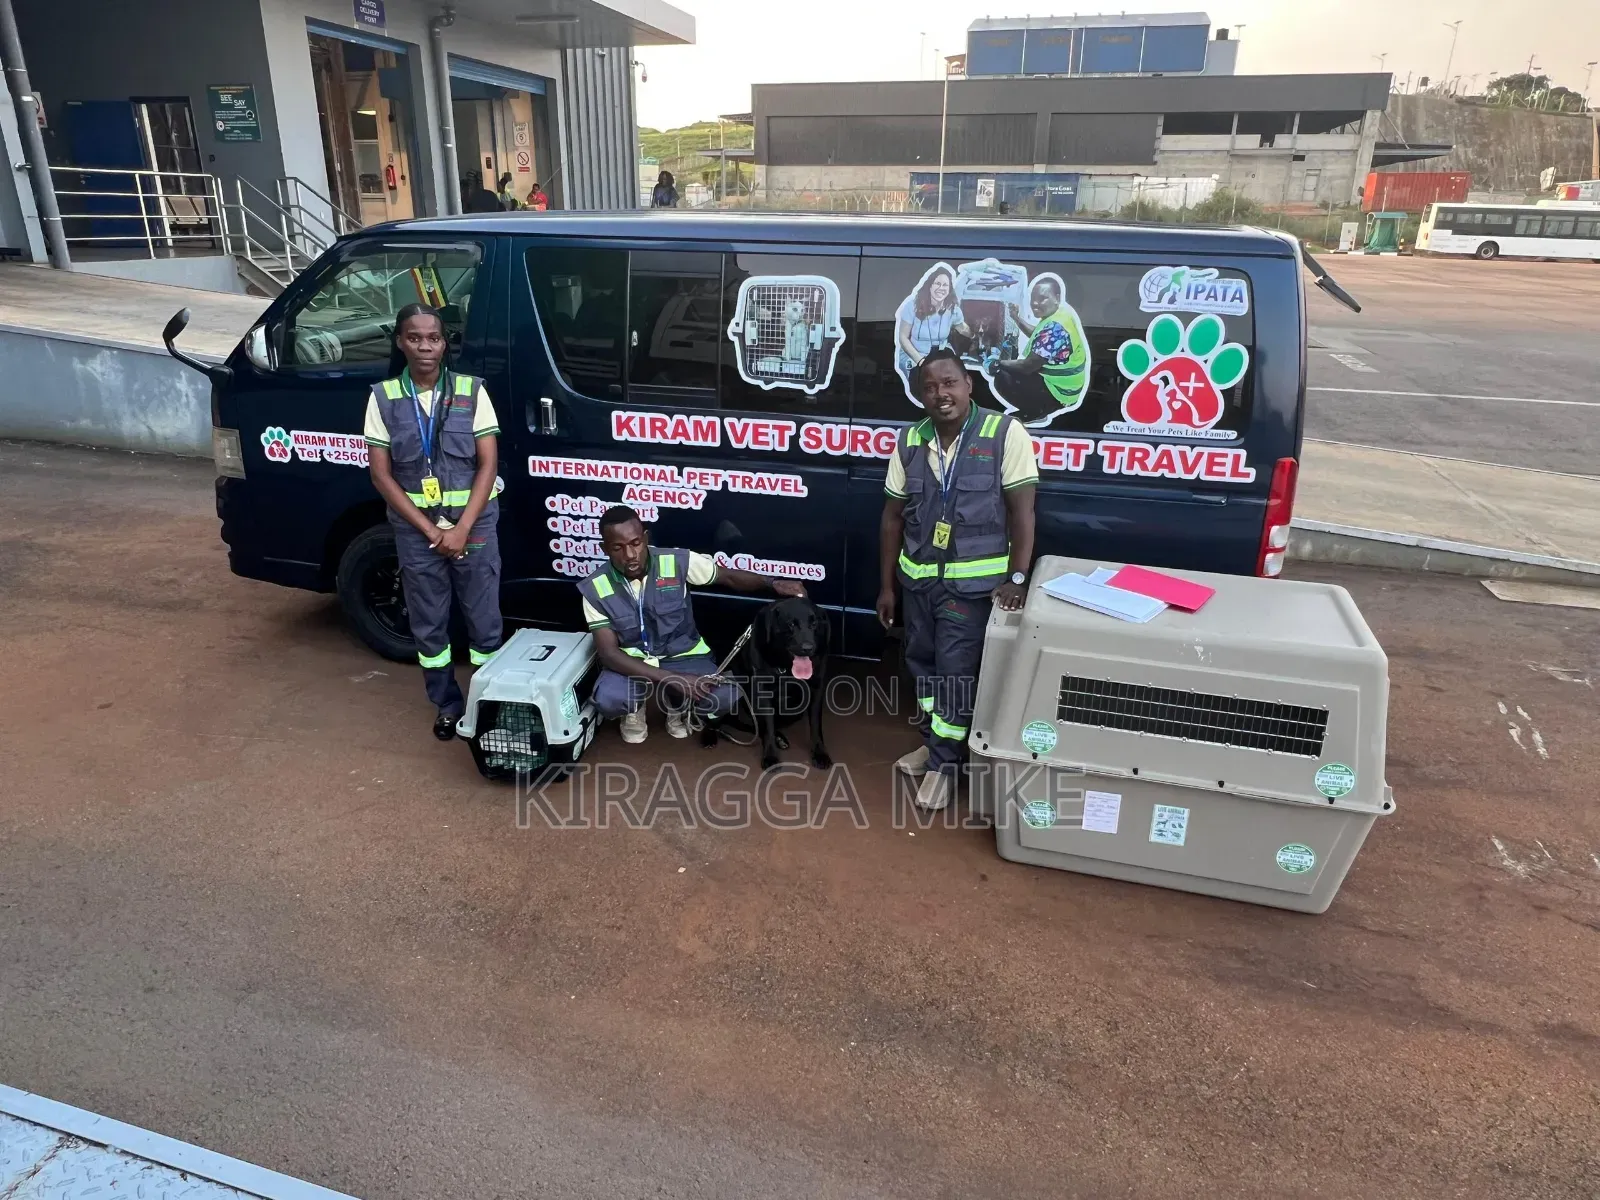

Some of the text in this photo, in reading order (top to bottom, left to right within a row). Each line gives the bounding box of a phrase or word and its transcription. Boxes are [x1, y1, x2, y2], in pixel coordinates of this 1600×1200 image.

[220, 94, 232, 102] SEE
[1185, 282, 1244, 304] IPATA
[615, 414, 897, 455] KIRAM VET SURG
[1168, 428, 1183, 436] Pets
[1185, 429, 1203, 437] Like
[293, 433, 327, 447] KIRAM
[328, 436, 347, 448] VET
[298, 448, 322, 459] Tel:
[1102, 445, 1251, 479] TRAVEL
[531, 459, 804, 493] INTERNATIONAL PET TRAVEL
[625, 488, 703, 506] AGENCY
[560, 498, 584, 512] Pet
[562, 519, 585, 533] Pet
[565, 541, 588, 555] Pet
[567, 561, 590, 575] Pet
[734, 556, 822, 578] Clearances
[1320, 779, 1349, 787] ANIMALS
